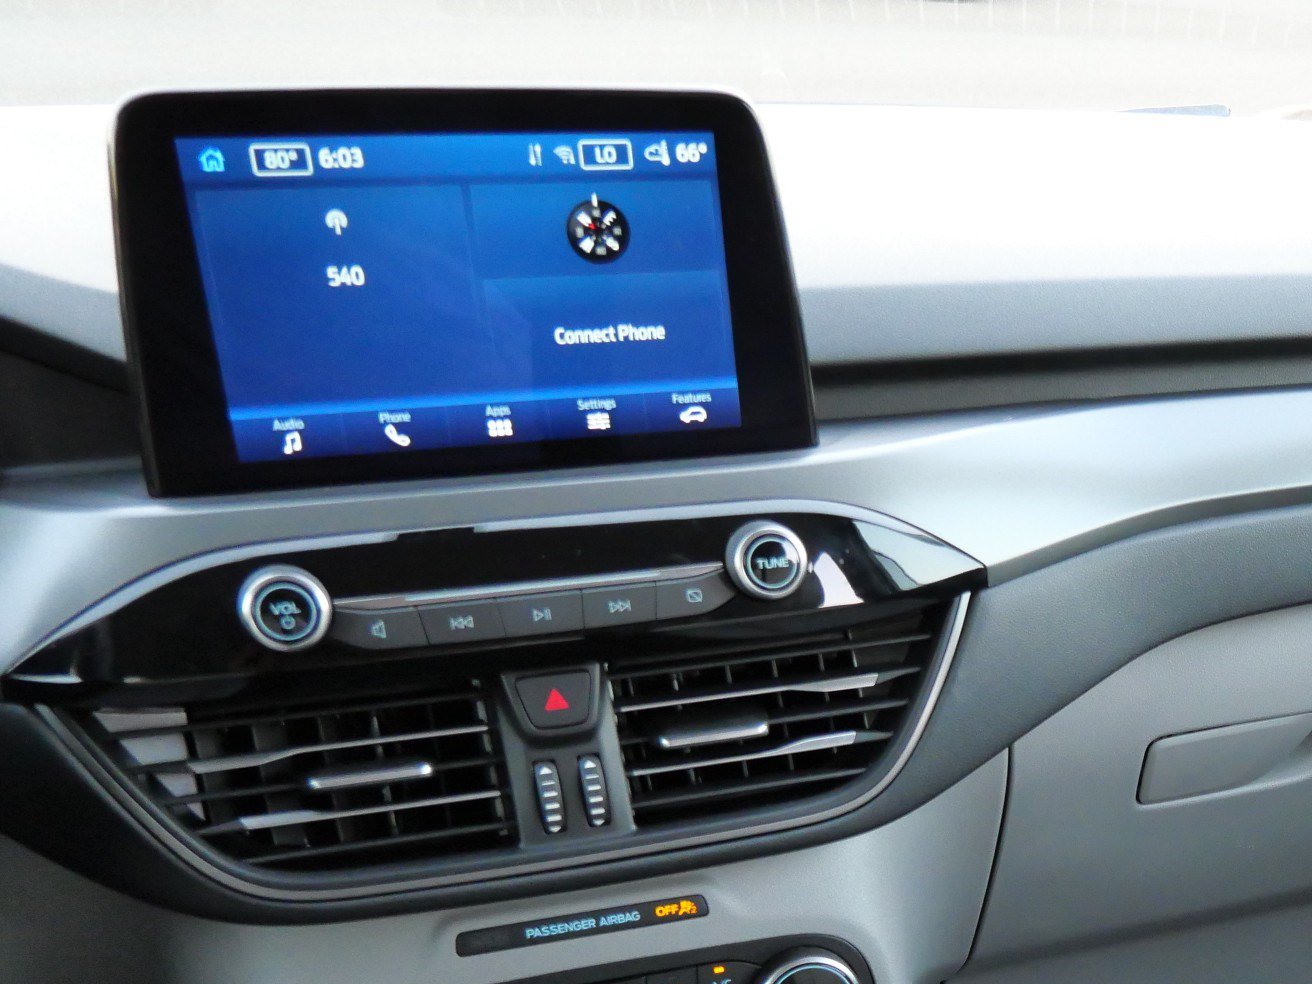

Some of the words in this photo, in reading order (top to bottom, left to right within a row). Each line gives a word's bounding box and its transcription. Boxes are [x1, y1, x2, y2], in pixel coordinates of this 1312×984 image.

[318, 146, 365, 169] 6:03
[326, 264, 365, 287] 540
[554, 325, 617, 345] Connect
[617, 322, 666, 342] Phone
[576, 397, 617, 411] Settings
[671, 392, 712, 405] Features
[377, 410, 412, 424] Phone
[485, 403, 512, 417] Apps
[272, 417, 305, 431] Audio
[756, 556, 790, 570] TUNE
[269, 600, 302, 616] VOL
[655, 904, 679, 918] OFF
[525, 917, 597, 939] PASSENGER
[599, 910, 641, 927] AIRBAG
